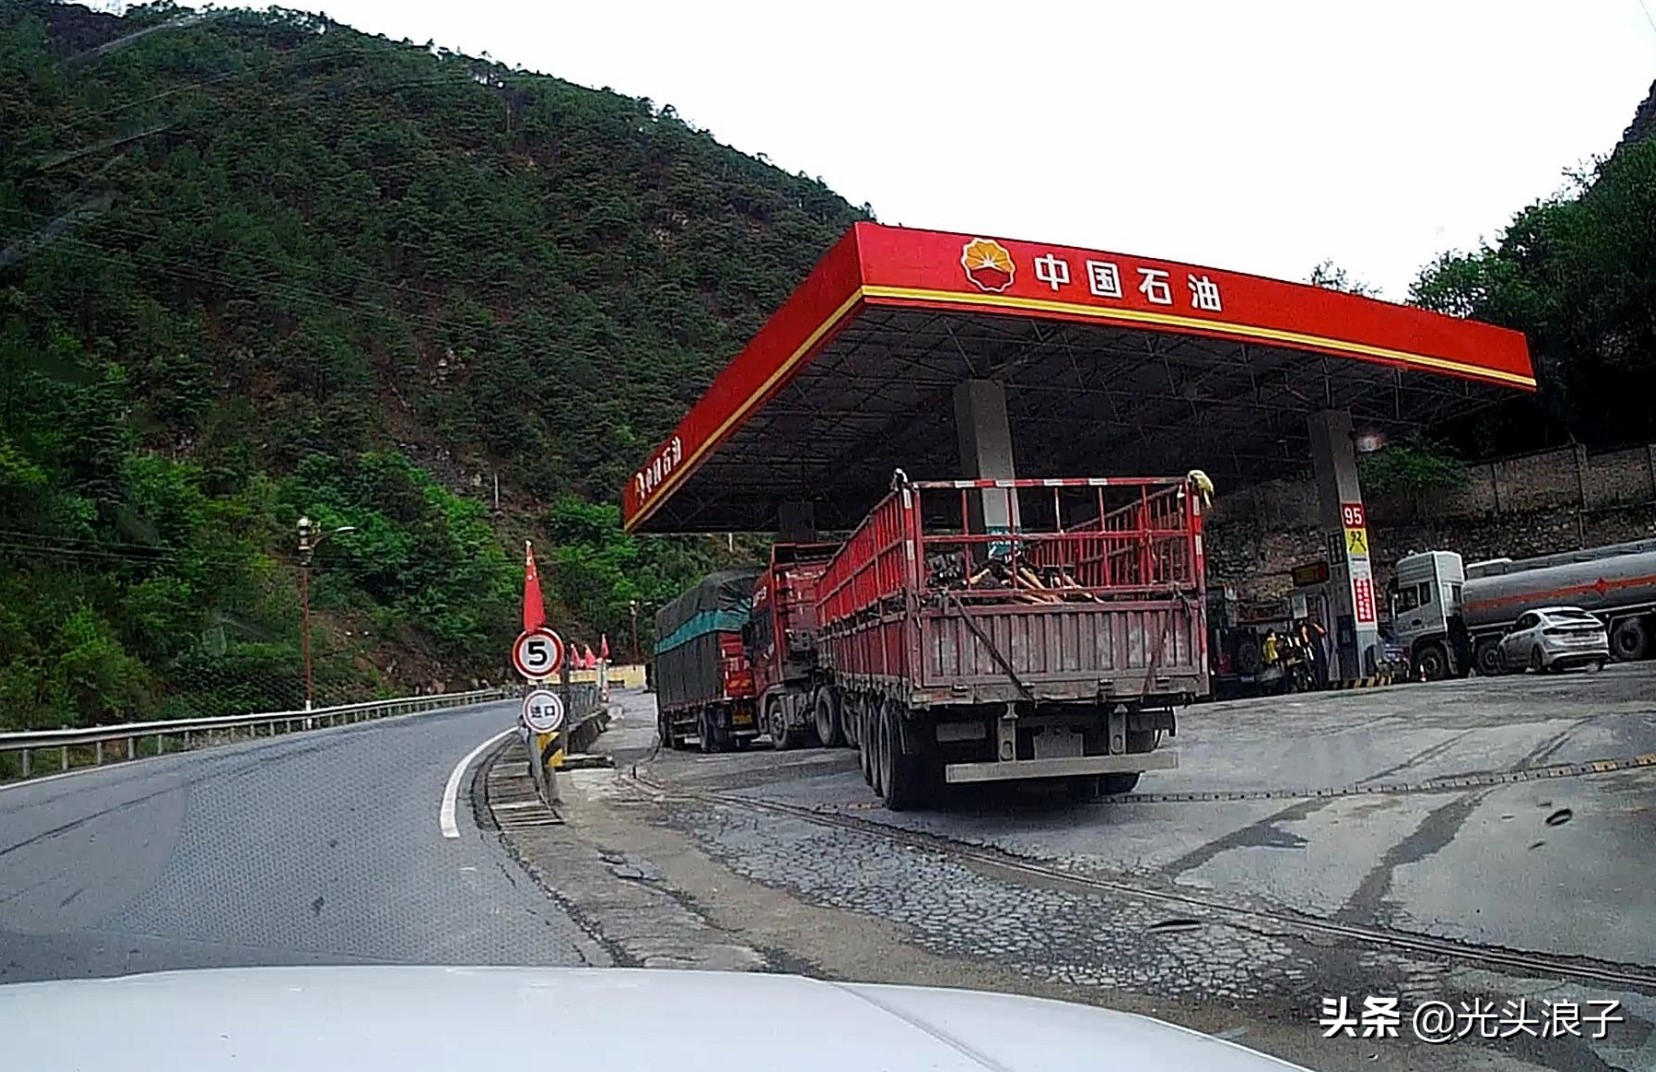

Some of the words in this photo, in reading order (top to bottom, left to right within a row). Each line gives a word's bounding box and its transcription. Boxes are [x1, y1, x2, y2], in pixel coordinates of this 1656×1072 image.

[1034, 253, 1223, 311] 中国石油
[1344, 506, 1363, 525] 95
[528, 641, 548, 666] 5
[530, 705, 555, 718] 进口
